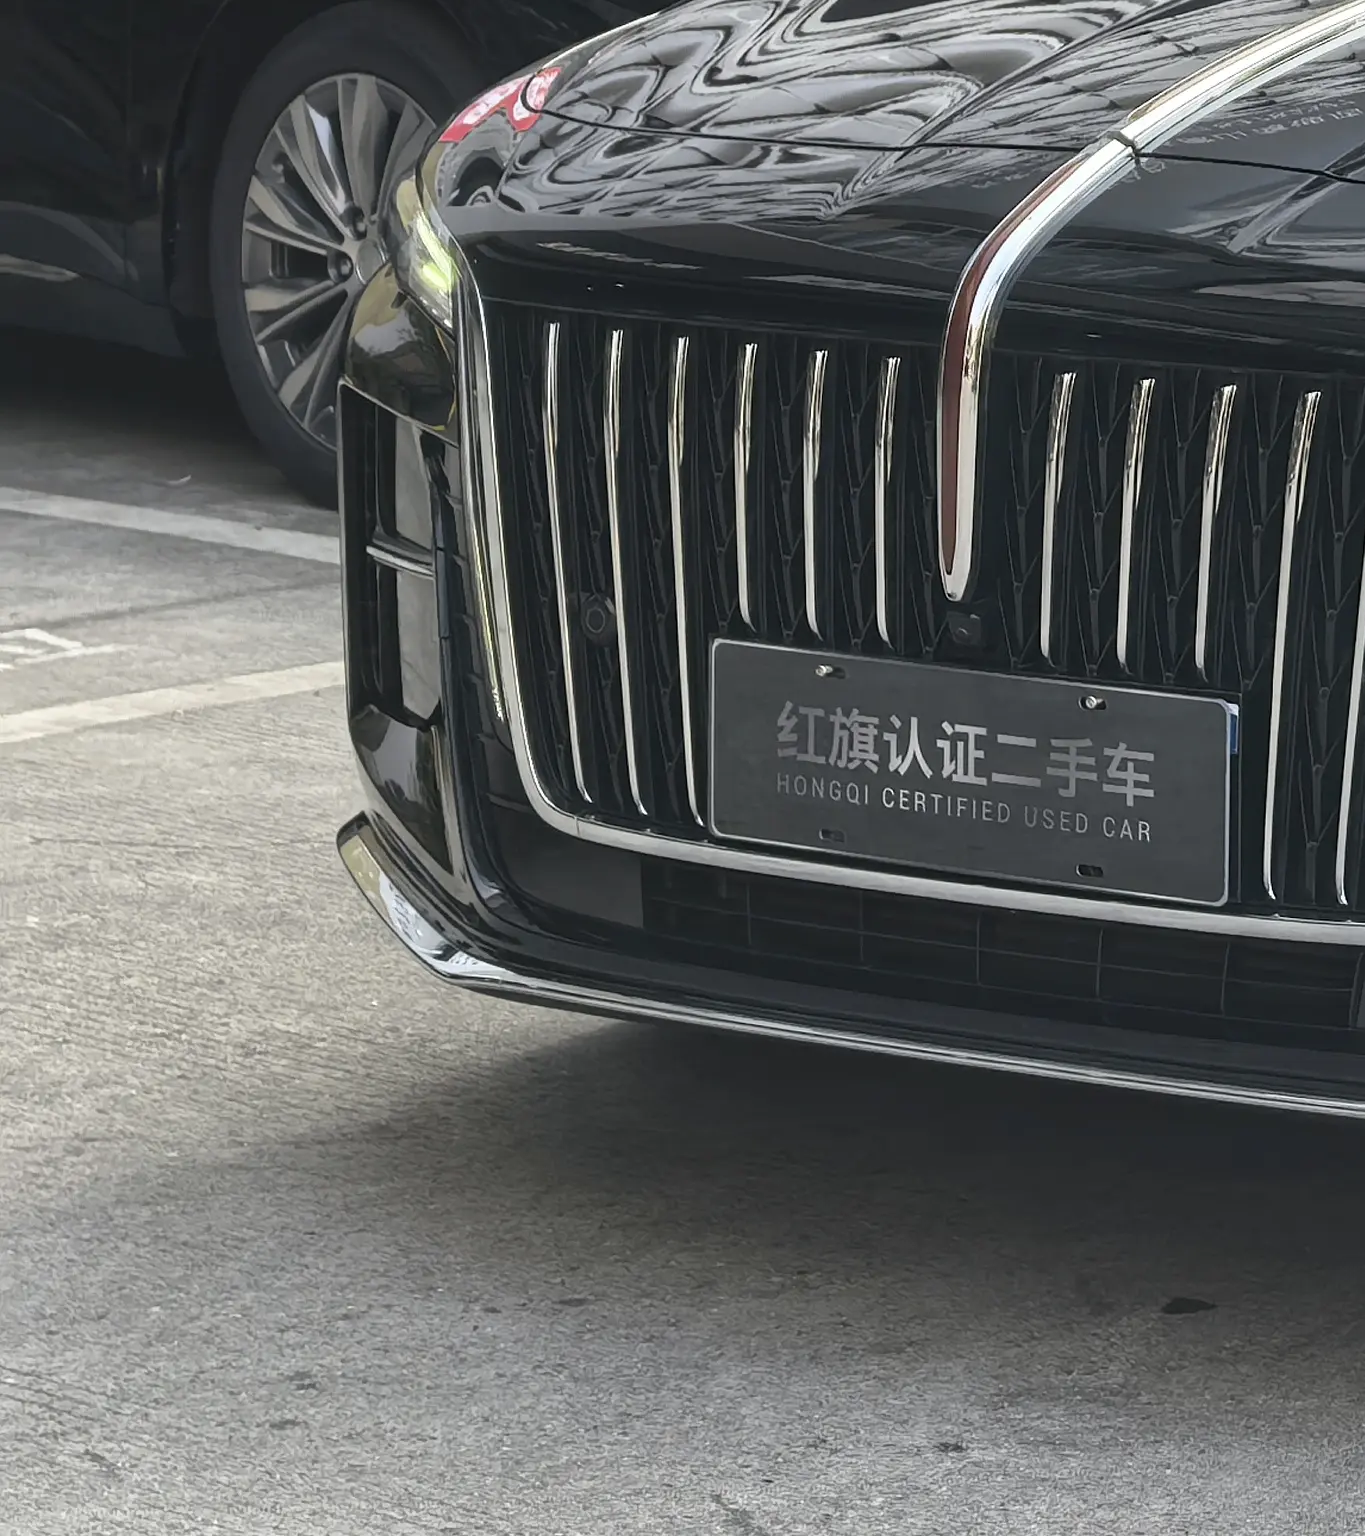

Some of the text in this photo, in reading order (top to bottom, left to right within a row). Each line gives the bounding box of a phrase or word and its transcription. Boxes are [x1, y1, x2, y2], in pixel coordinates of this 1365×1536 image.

[776, 699, 1156, 808] 红旗认证二手车
[776, 771, 1153, 843] HONGQI CERTIFIED USED CAR
